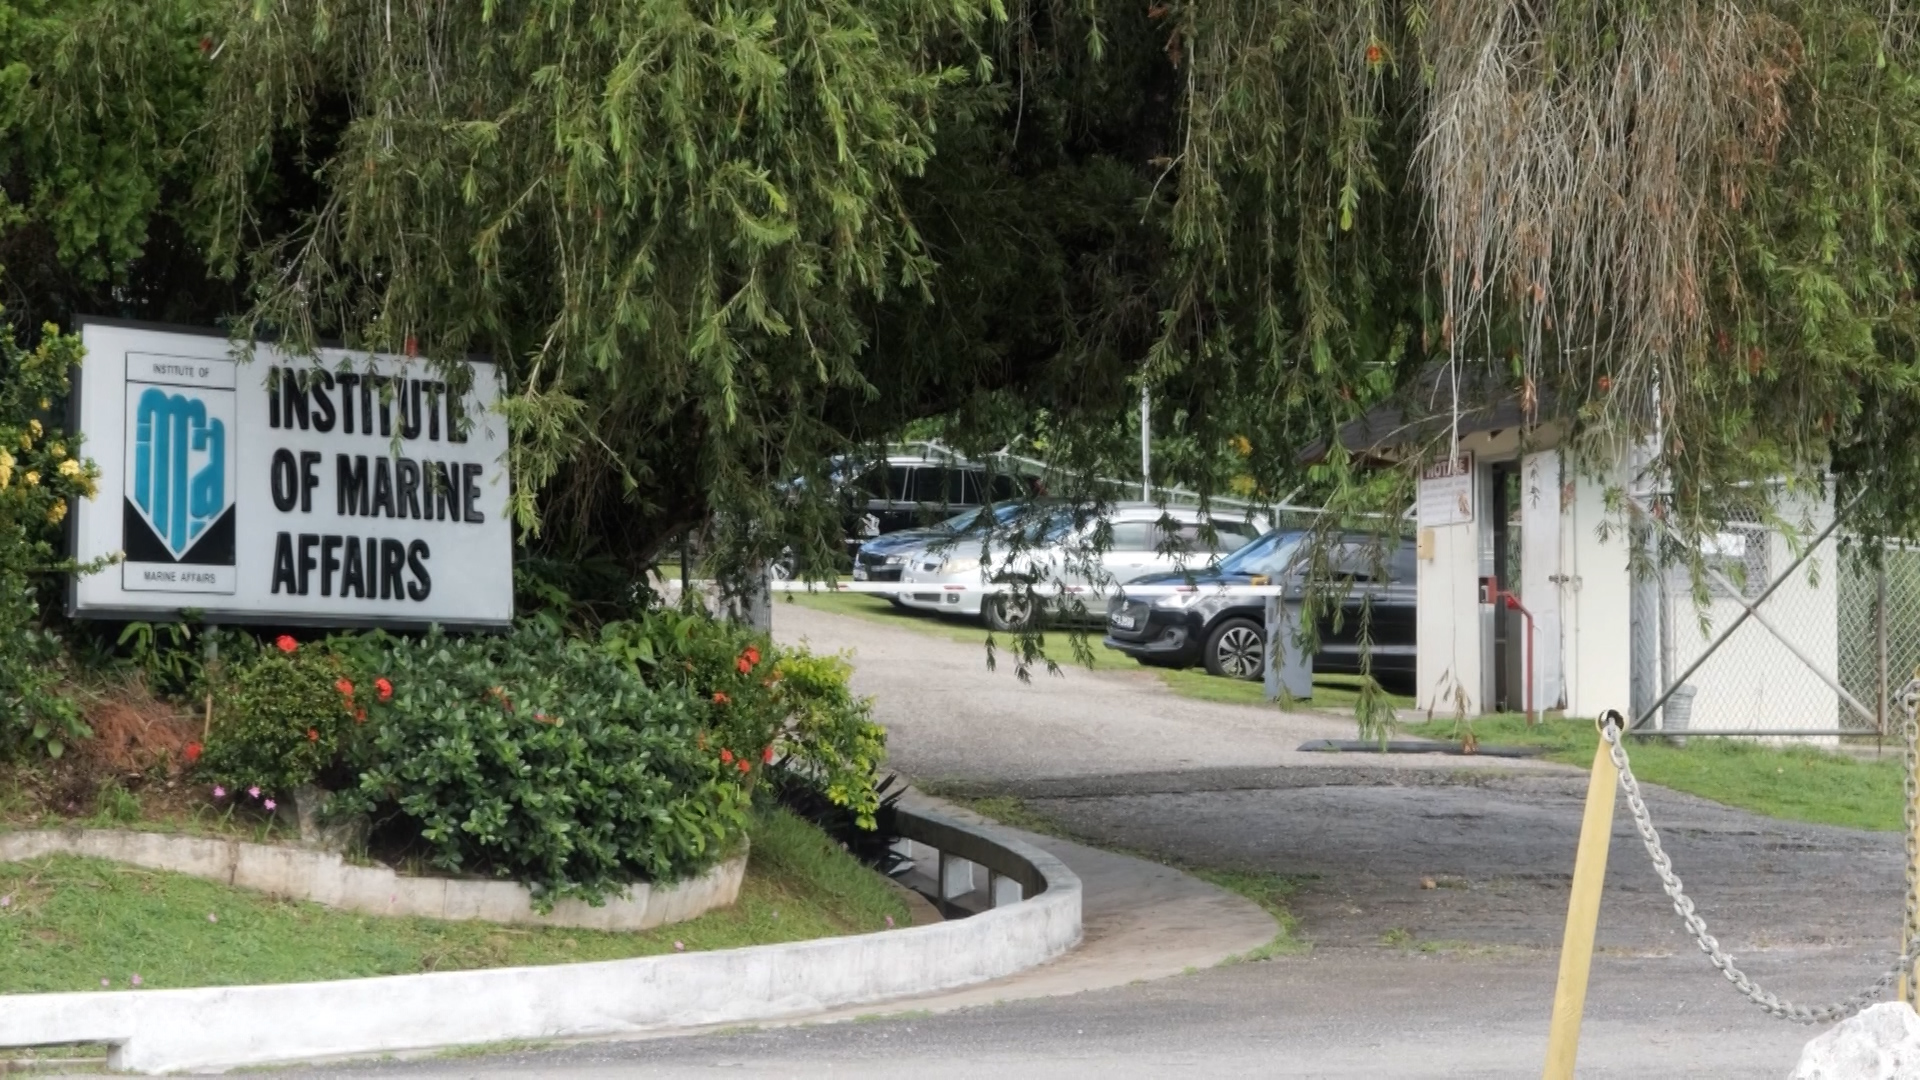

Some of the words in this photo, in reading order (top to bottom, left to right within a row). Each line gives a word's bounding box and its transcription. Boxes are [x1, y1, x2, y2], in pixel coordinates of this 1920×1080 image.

[152, 364, 195, 378] INSTITUTE
[198, 367, 210, 378] OF
[1427, 459, 1465, 478] NOTE
[270, 448, 322, 513] OF
[336, 453, 485, 524] MARINE
[271, 531, 431, 601] AFFAIRS
[143, 571, 176, 582] MARINE
[180, 572, 216, 584] AFFAIRS
